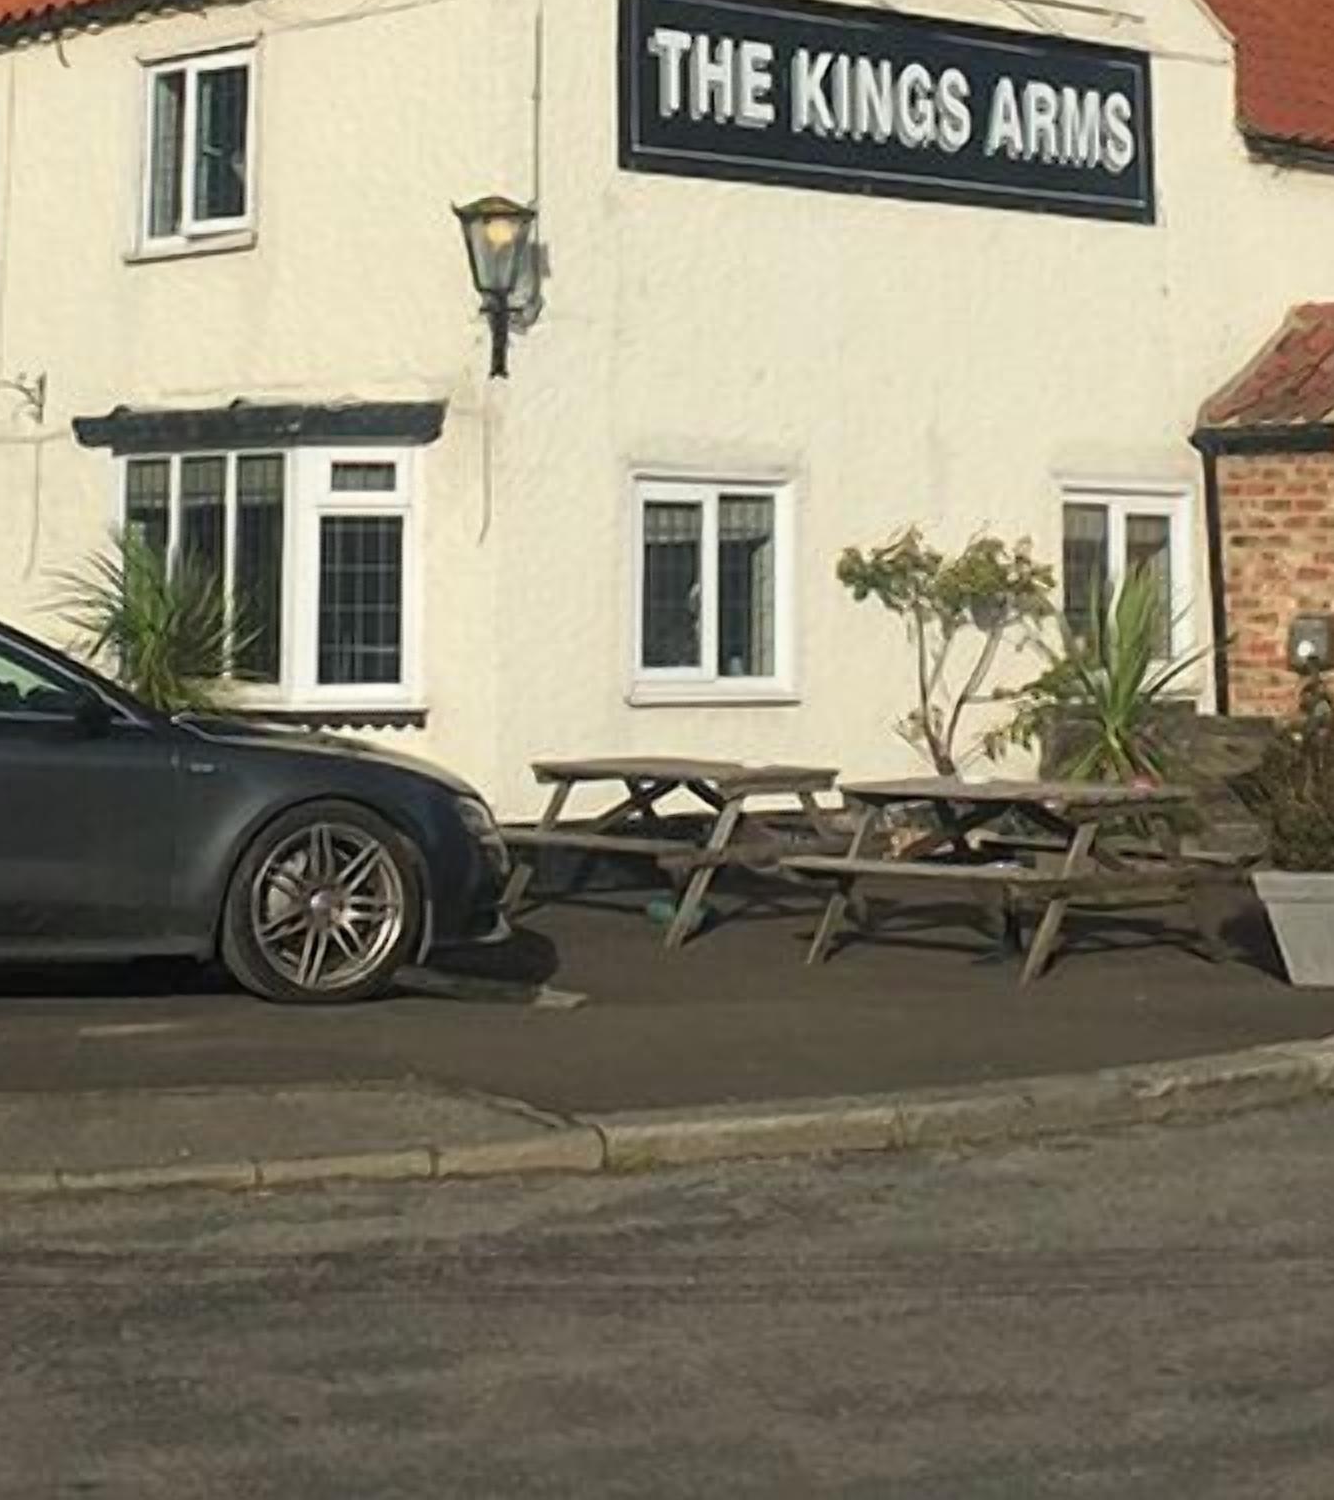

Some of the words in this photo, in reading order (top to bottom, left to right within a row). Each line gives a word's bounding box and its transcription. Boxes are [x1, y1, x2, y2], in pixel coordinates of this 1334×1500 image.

[648, 27, 776, 128] THE
[790, 48, 971, 152] KINGS
[982, 76, 1135, 175] ARMS
